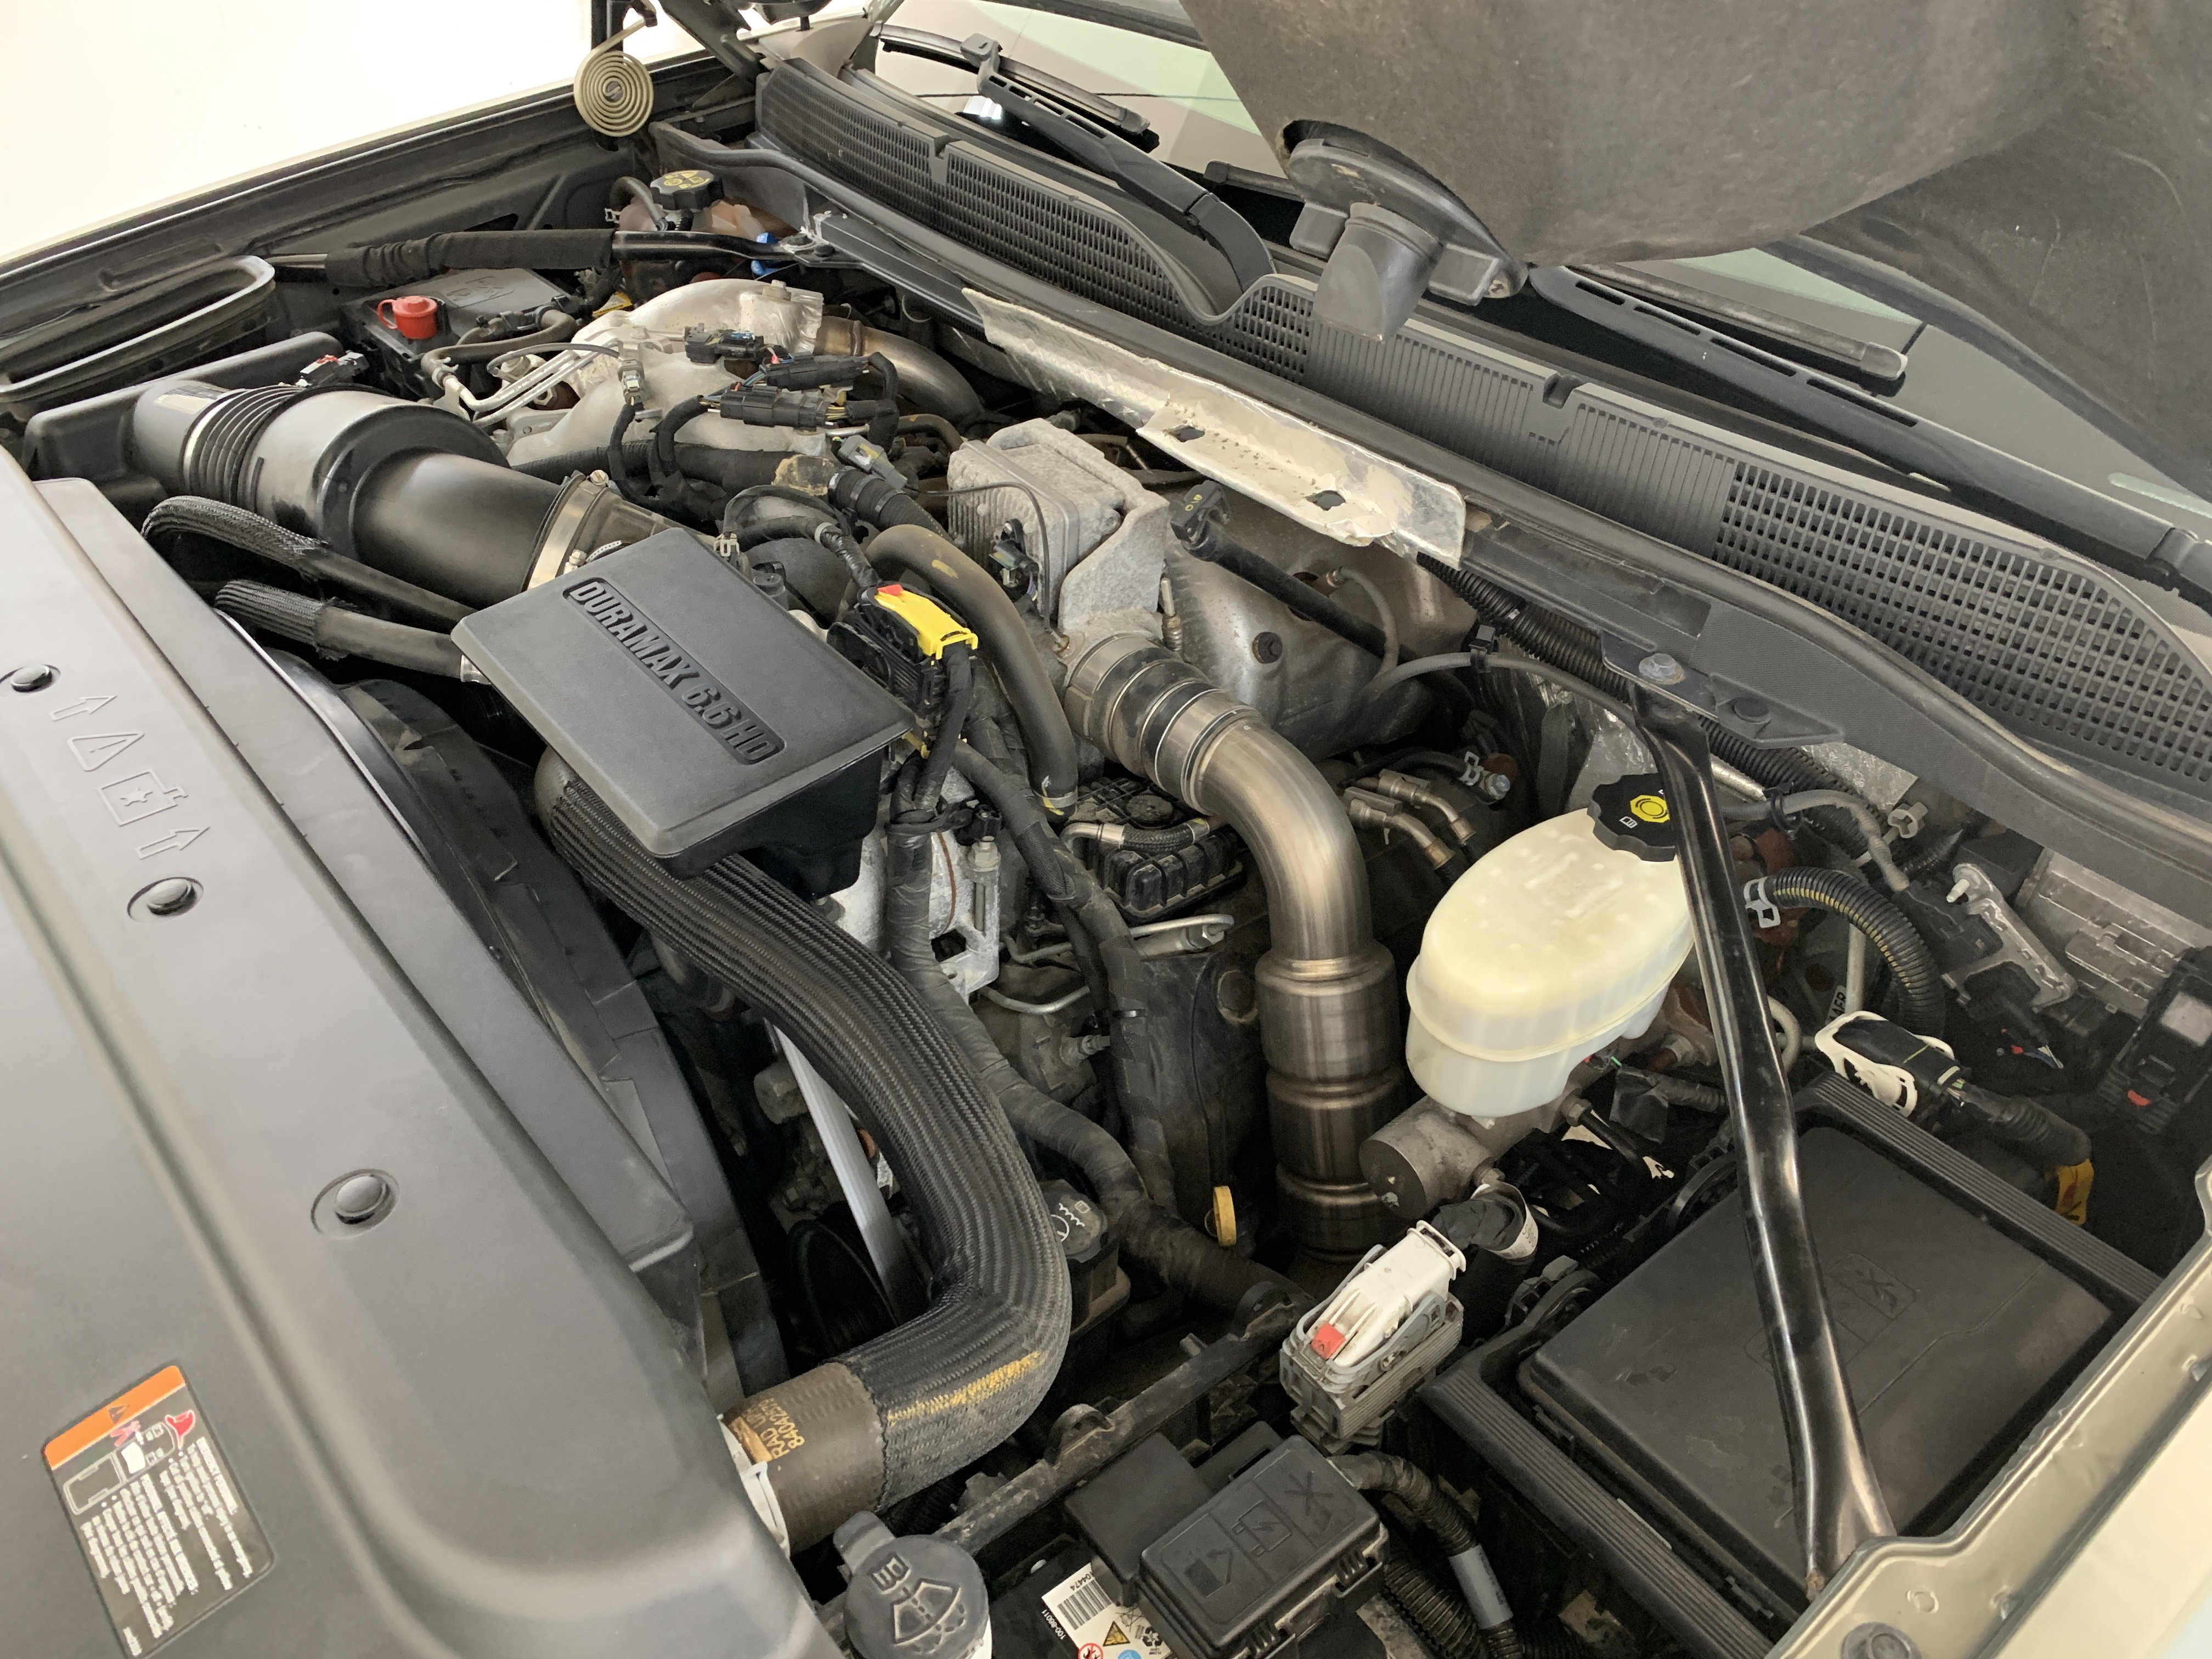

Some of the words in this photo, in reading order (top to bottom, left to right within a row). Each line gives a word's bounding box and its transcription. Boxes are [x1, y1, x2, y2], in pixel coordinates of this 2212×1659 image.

[569, 581, 699, 690] DURAMAX
[681, 683, 742, 729] 6.6
[721, 719, 778, 761] HD
[760, 1427, 790, 1459] RAD
